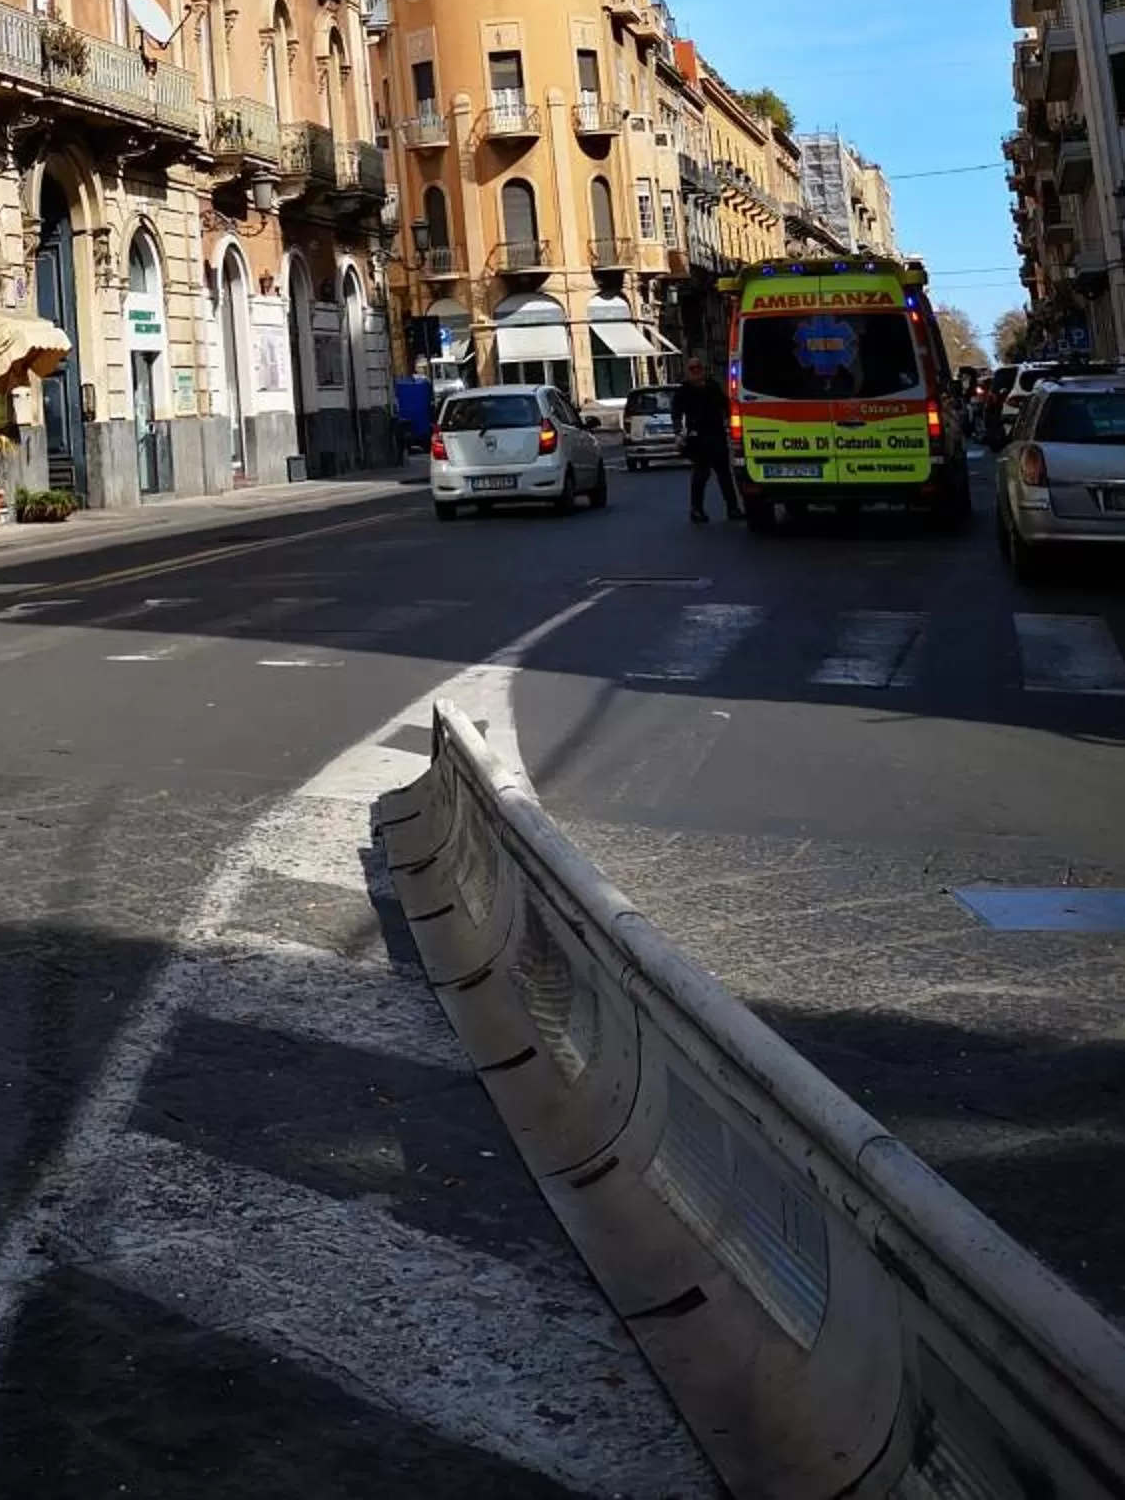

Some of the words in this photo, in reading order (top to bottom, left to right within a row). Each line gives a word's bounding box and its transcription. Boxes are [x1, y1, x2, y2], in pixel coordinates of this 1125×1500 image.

[753, 292, 895, 309] AMBULANZA
[750, 437, 776, 450] New
[782, 436, 810, 450] Città
[816, 437, 830, 450] Di
[835, 436, 882, 449] Catania
[887, 435, 924, 449] Onlus
